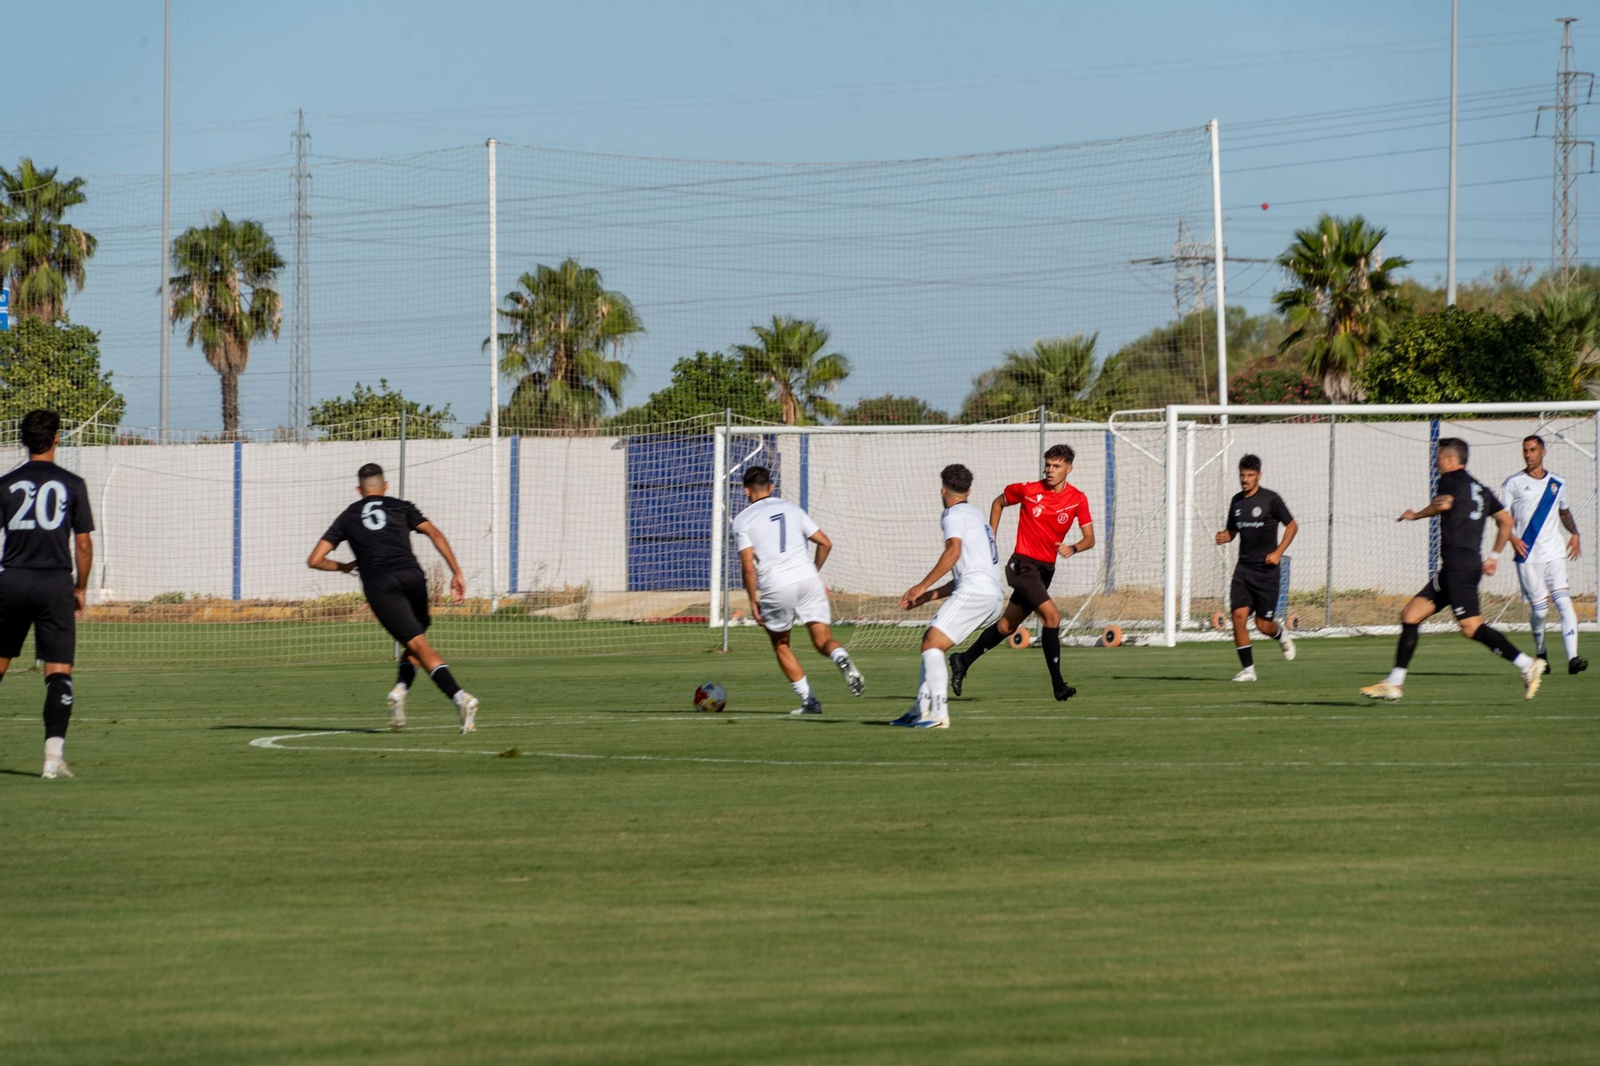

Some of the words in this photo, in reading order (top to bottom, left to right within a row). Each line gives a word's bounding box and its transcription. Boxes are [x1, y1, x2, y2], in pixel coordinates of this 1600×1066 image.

[8, 478, 67, 530] 20
[361, 501, 387, 531] 6
[1469, 481, 1485, 521] 5
[769, 513, 787, 554] 7
